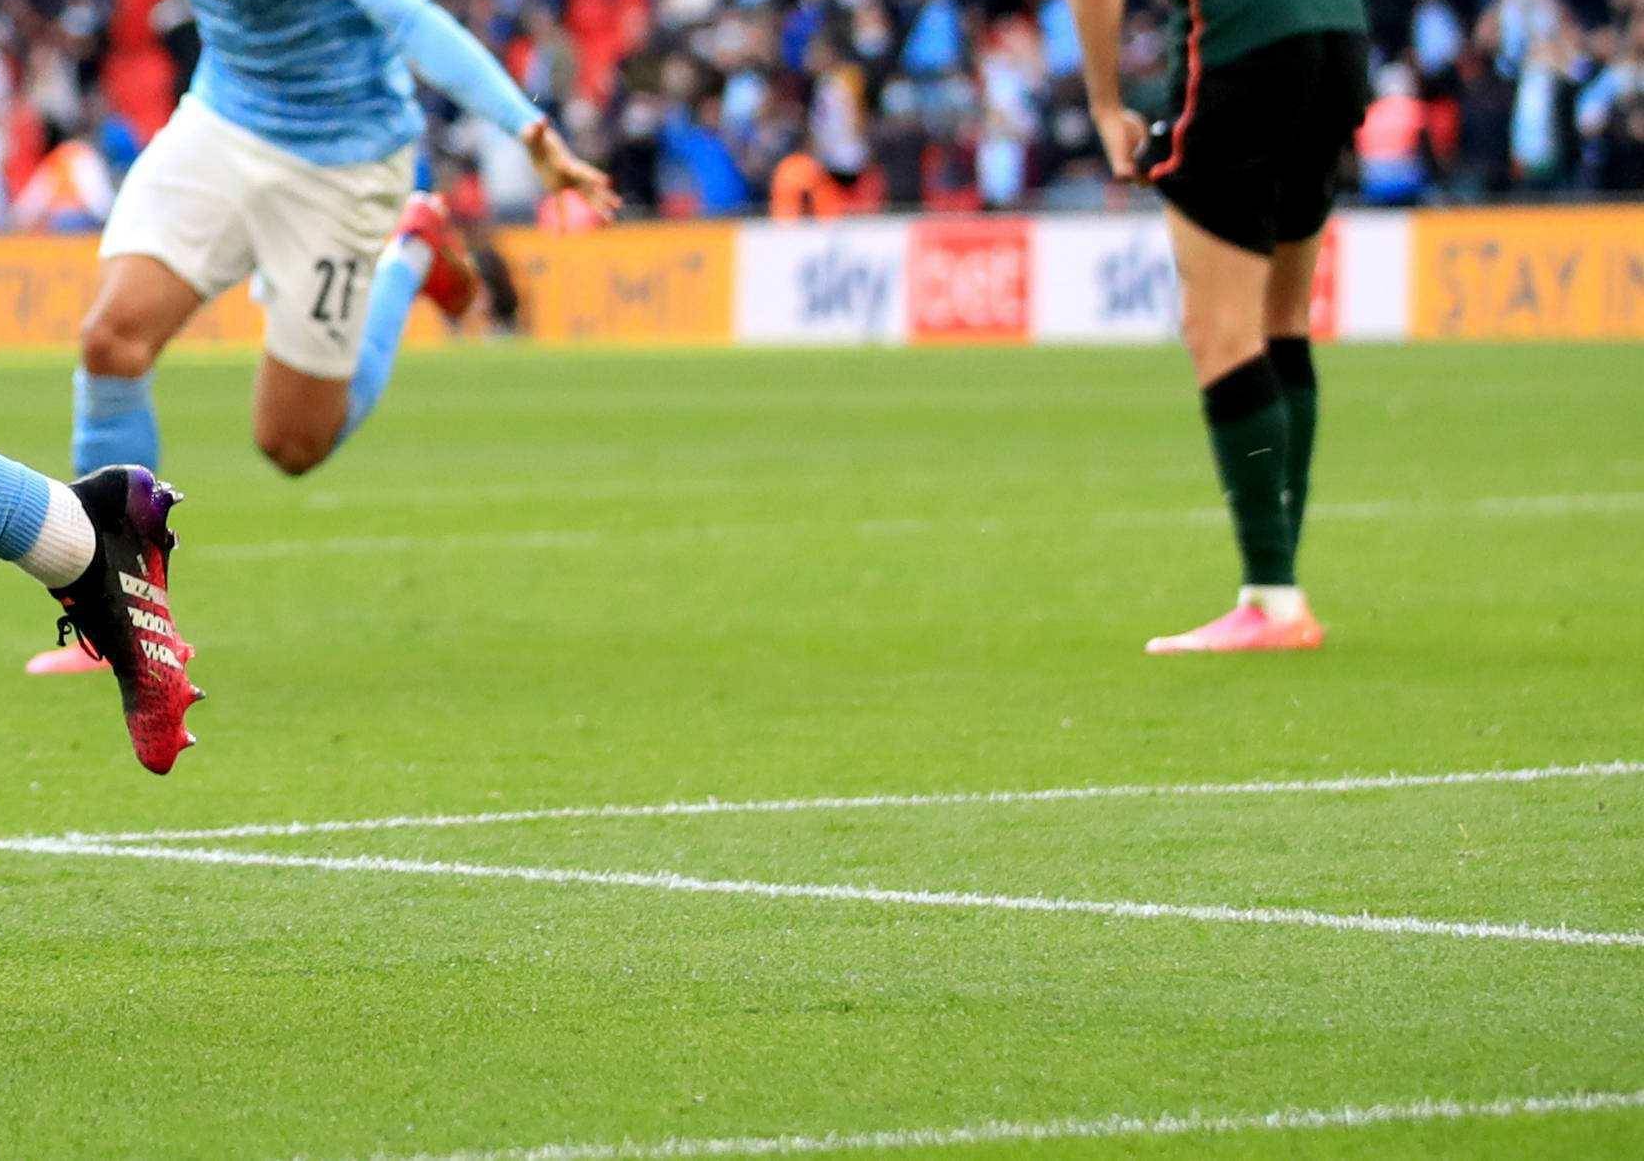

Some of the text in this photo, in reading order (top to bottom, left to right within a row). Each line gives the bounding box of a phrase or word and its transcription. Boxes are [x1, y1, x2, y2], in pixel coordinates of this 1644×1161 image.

[310, 258, 358, 322] 21
[792, 233, 1024, 338] sky bet
